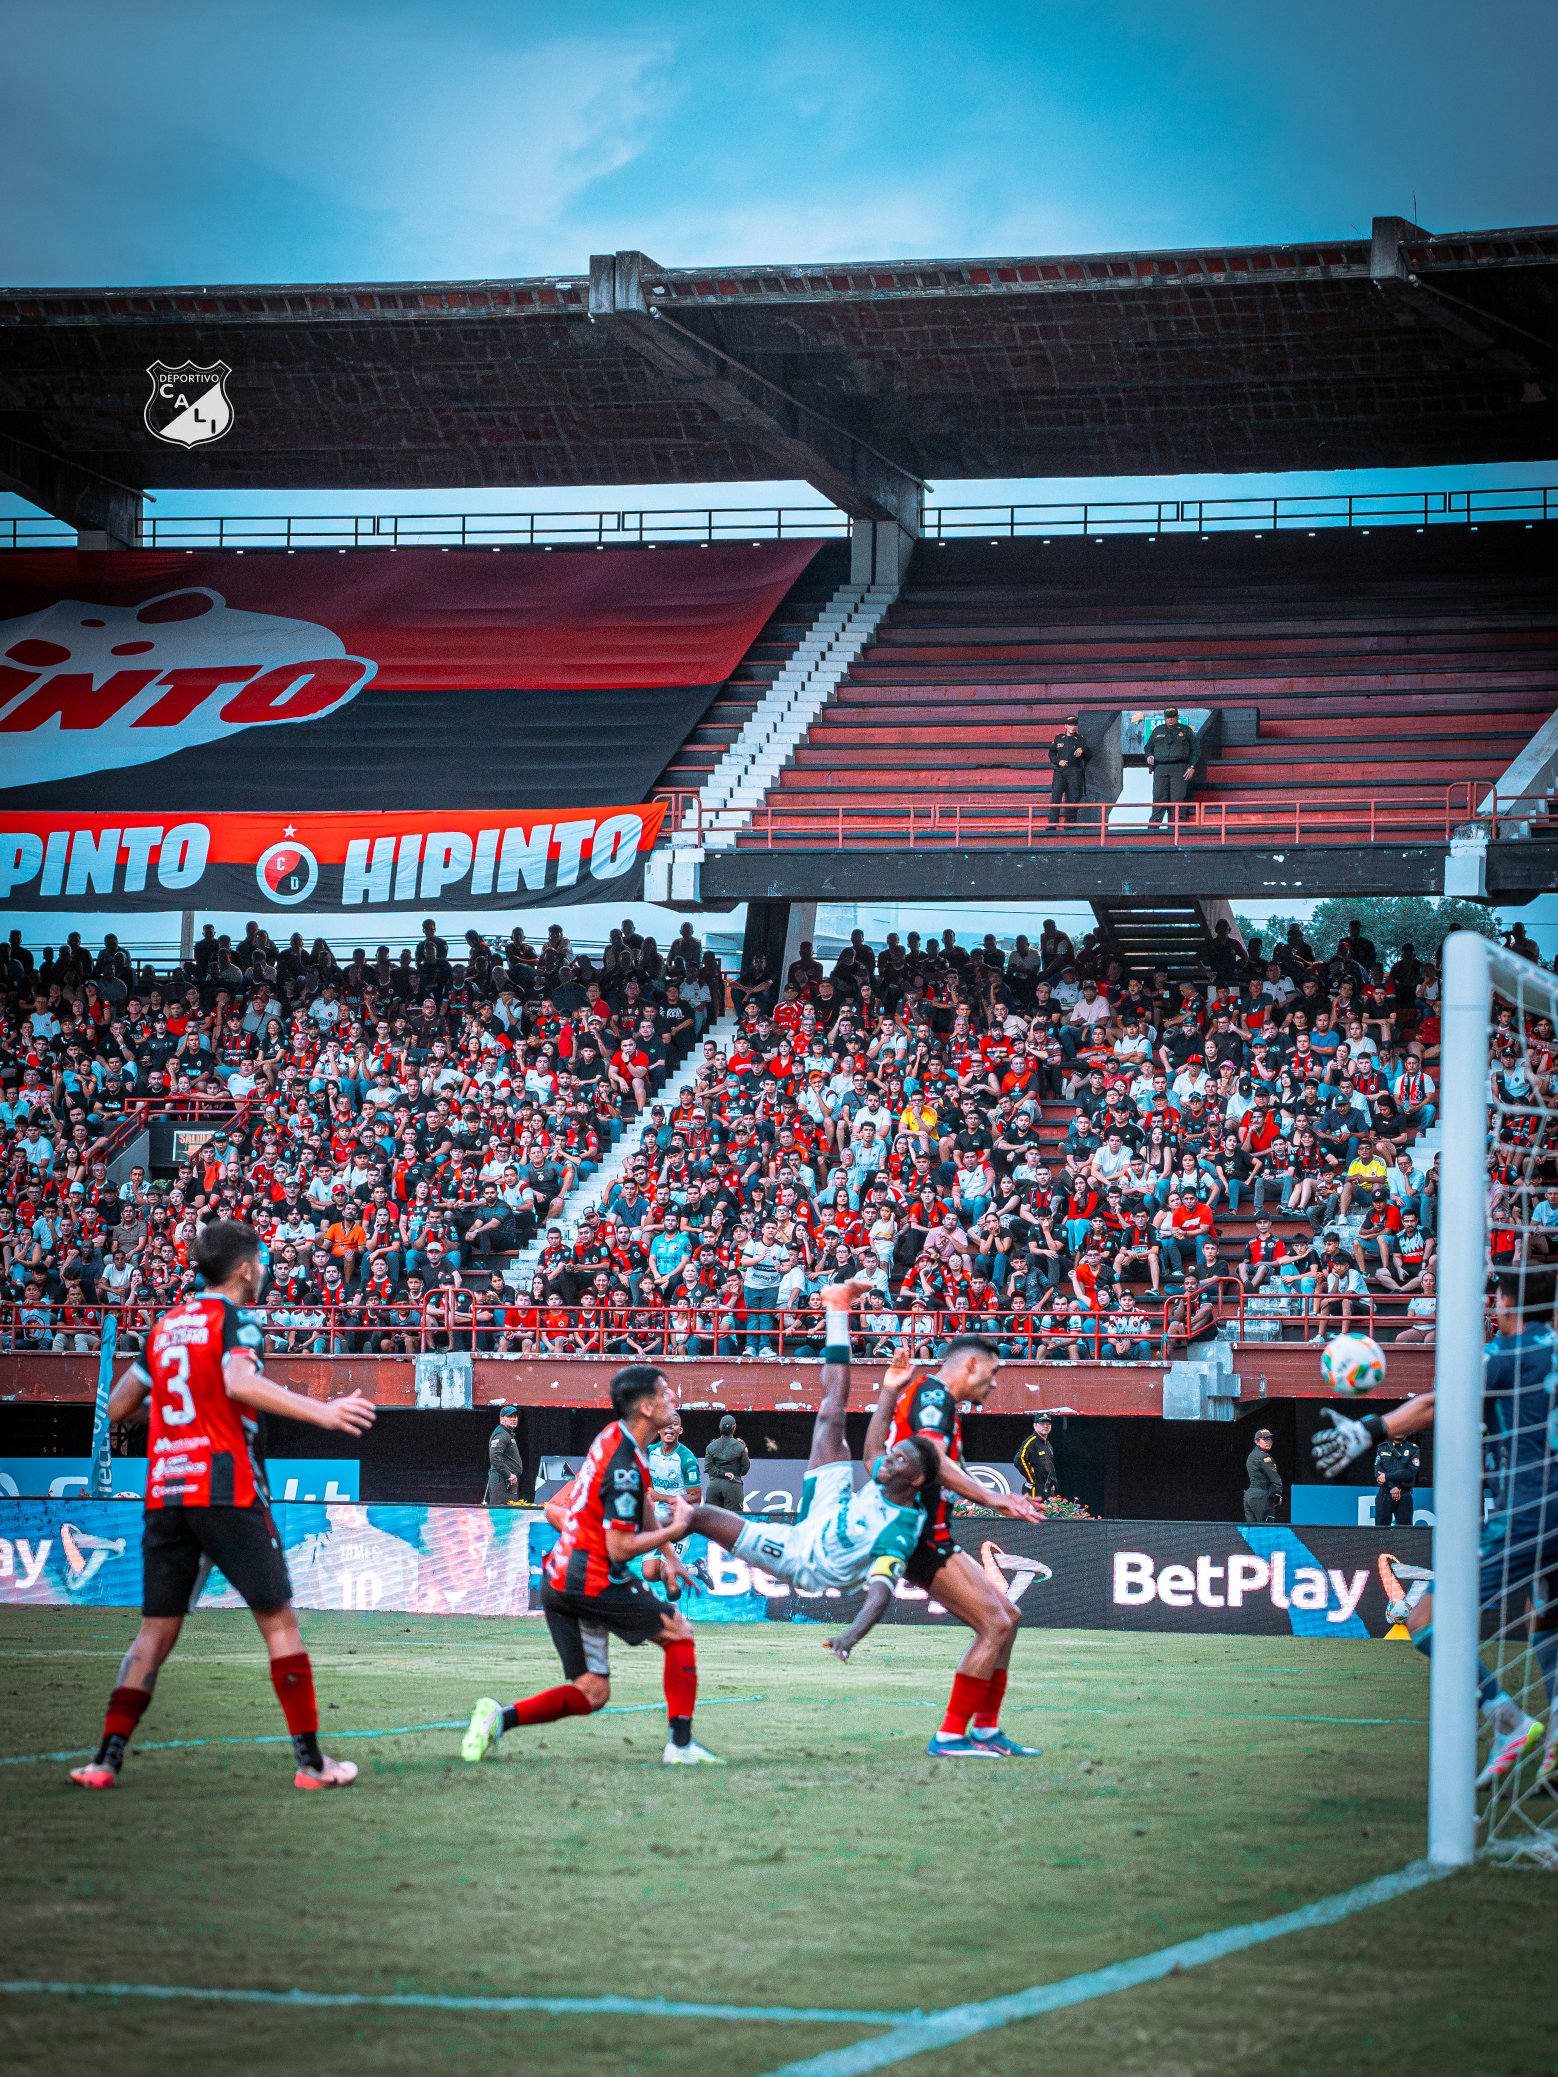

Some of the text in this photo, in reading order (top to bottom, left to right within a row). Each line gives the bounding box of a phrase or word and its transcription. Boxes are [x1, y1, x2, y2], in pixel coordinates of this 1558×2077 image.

[341, 813, 643, 905] HIPINTO
[160, 1344, 197, 1426] 3
[613, 1469, 640, 1485] DG
[762, 1538, 785, 1559] 18
[335, 1570, 383, 1610] 10
[1113, 1552, 1370, 1623] BetPlay
